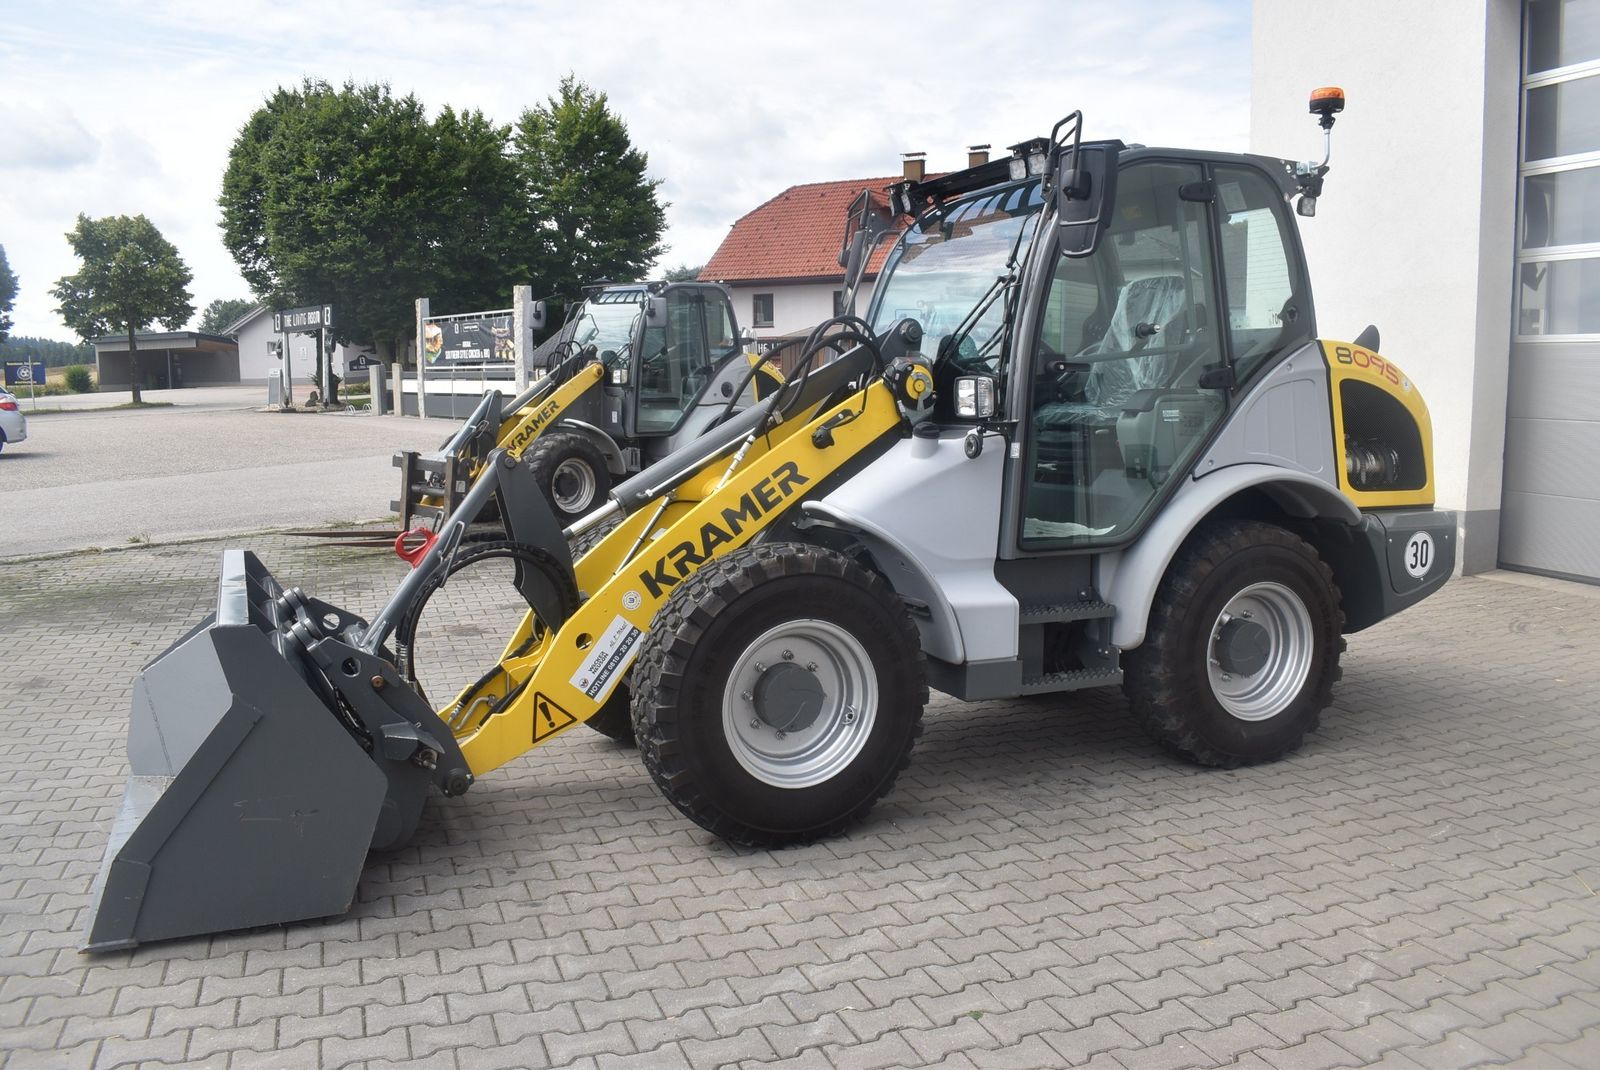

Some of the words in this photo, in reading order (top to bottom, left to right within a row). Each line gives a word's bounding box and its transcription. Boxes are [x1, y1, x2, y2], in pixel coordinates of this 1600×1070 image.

[1336, 346, 1399, 385] 8095
[639, 461, 810, 599] KRAMER
[1409, 538, 1429, 570] 30
[588, 651, 605, 672] WACKER
[588, 670, 610, 697] HOTLINE
[607, 655, 620, 670] 0810
[619, 644, 628, 653] 20
[625, 636, 634, 646] 20
[631, 629, 639, 638] 30
[592, 653, 609, 675] NEUSON
